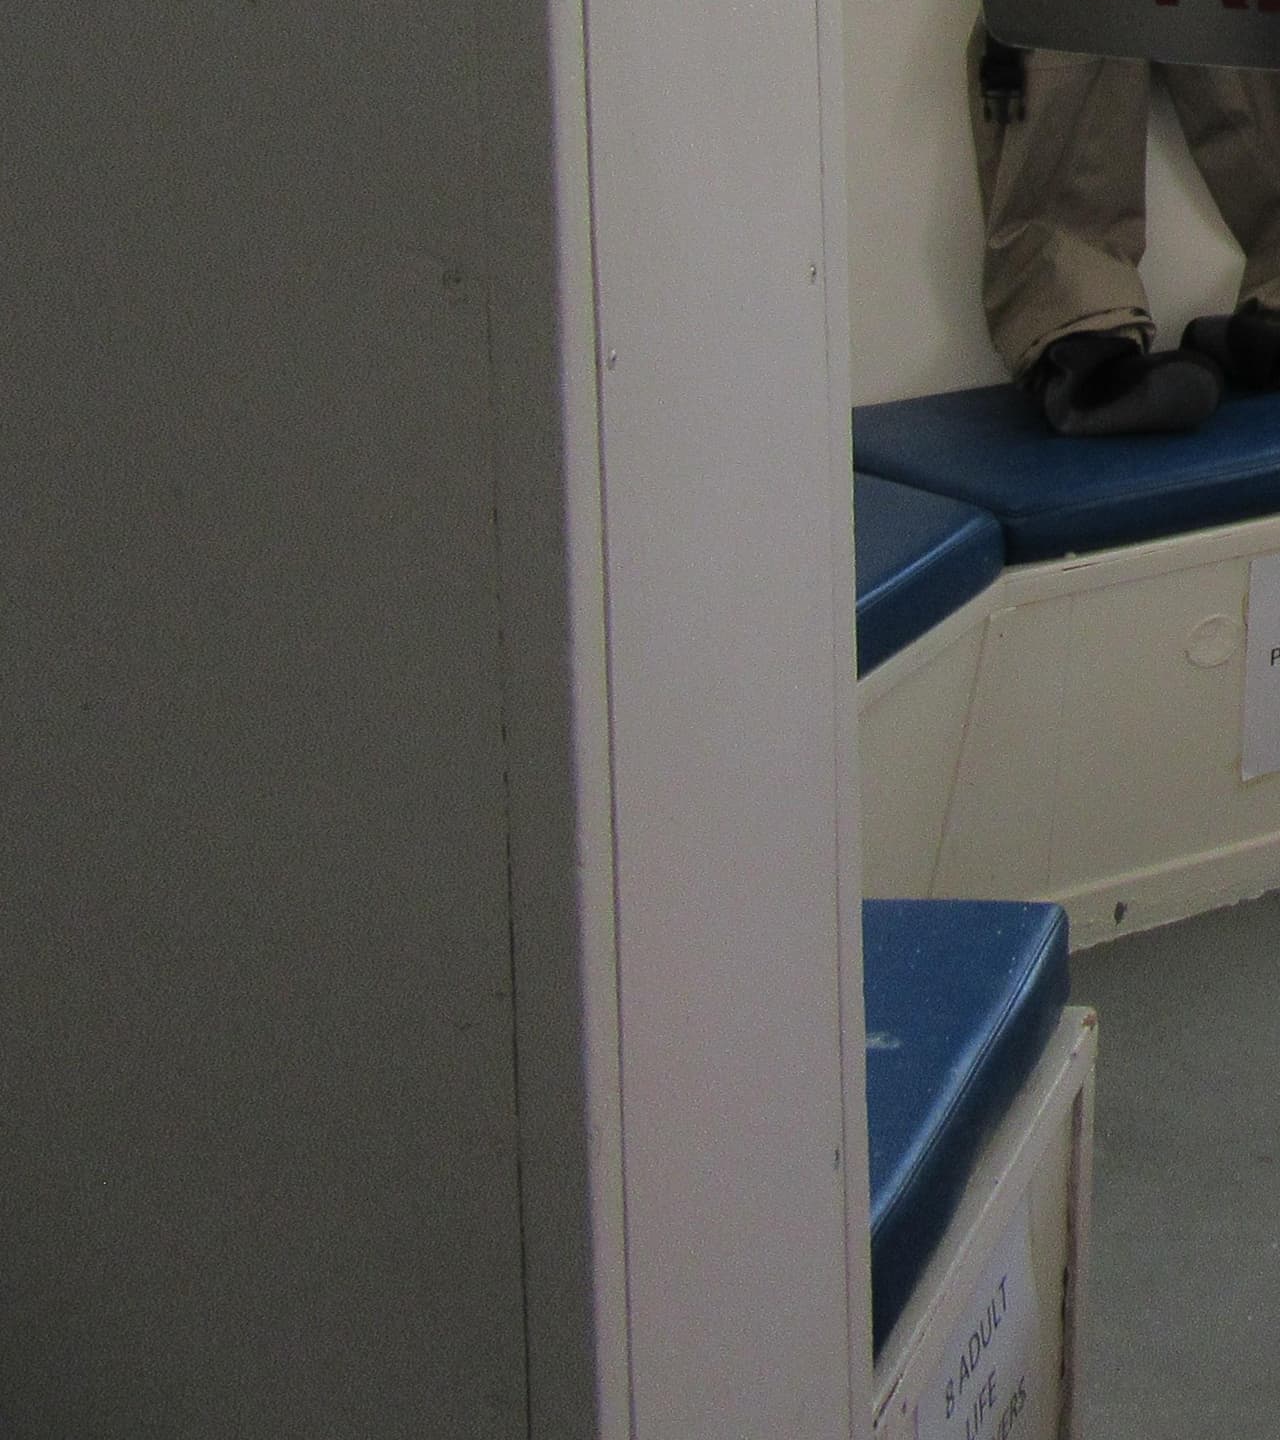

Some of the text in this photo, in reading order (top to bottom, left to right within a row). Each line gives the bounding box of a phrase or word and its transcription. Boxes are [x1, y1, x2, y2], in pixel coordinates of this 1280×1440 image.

[945, 1275, 1007, 1419] 8 ADULT
[966, 1370, 997, 1440] LIFE
